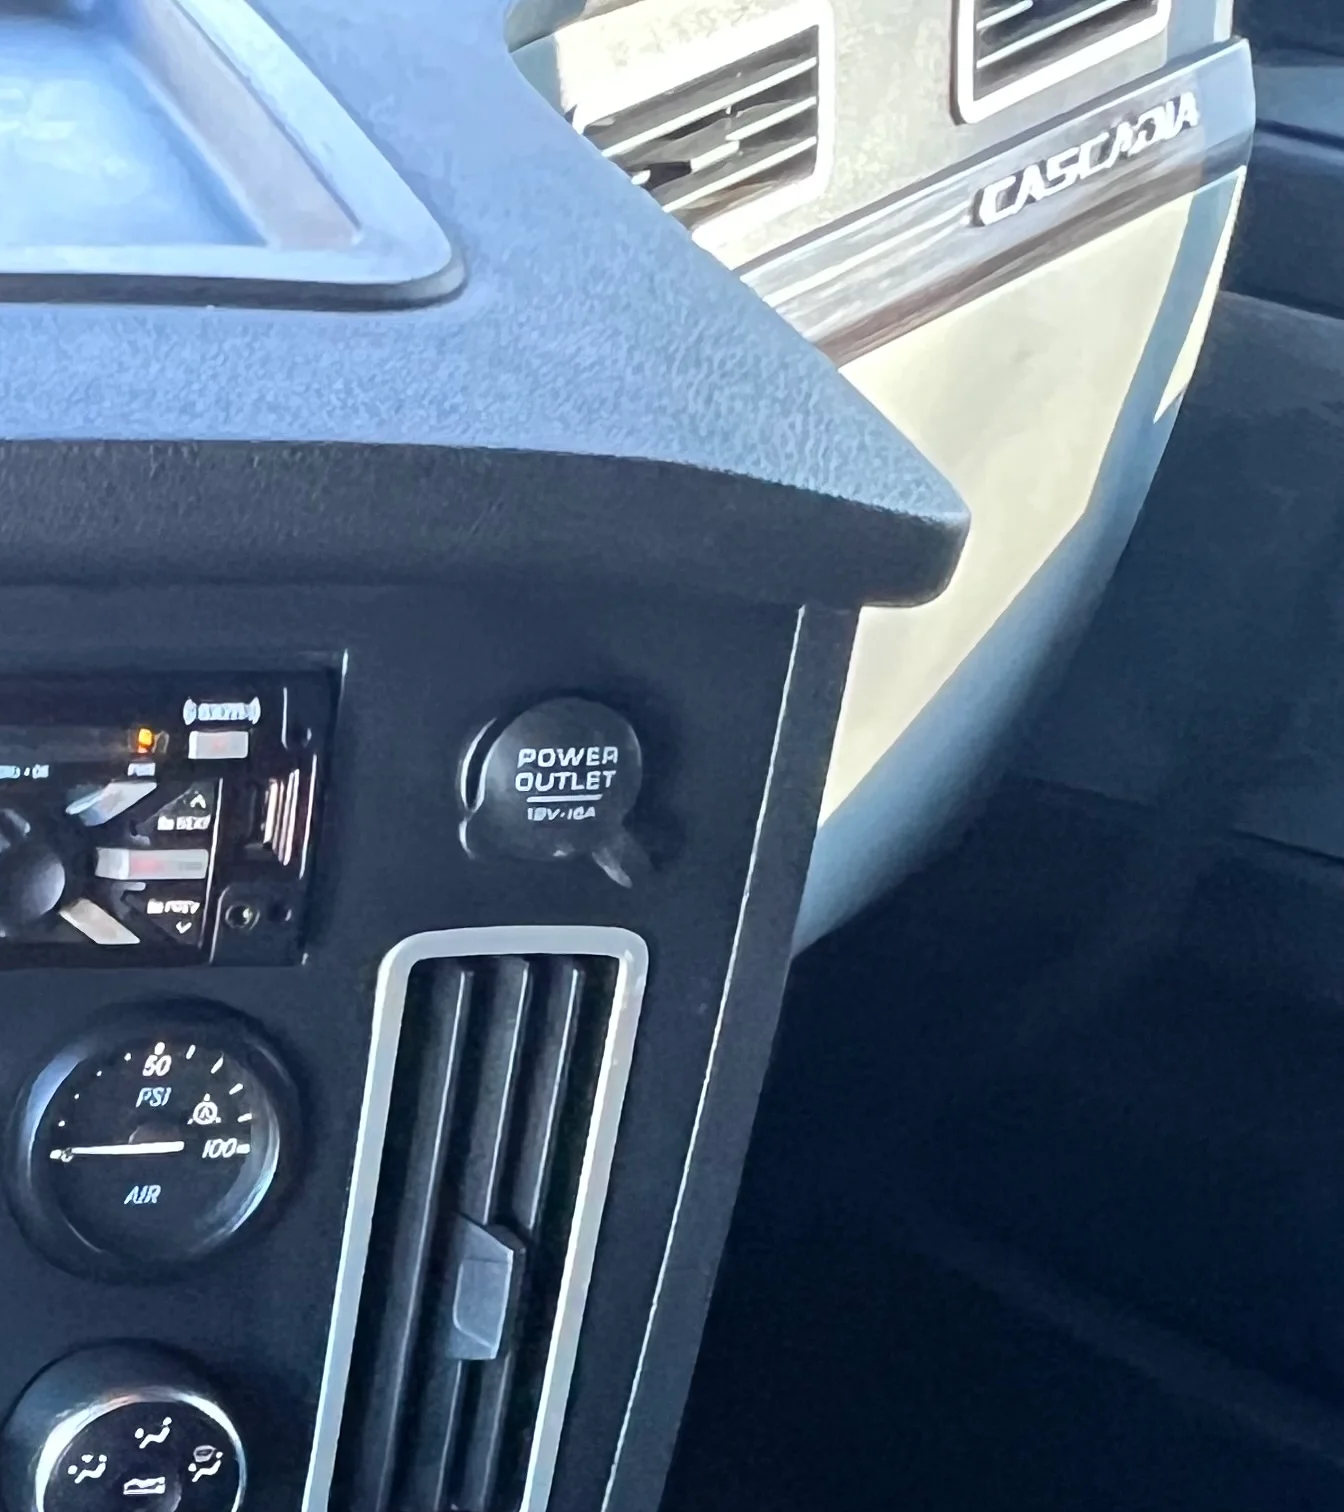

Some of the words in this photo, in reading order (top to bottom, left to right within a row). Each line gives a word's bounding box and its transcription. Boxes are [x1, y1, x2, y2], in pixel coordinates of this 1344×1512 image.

[979, 91, 1200, 226] CASCADIA
[517, 745, 618, 768] POWER
[515, 770, 617, 792] OUTLET
[142, 1054, 173, 1077] 50
[135, 1086, 173, 1109] PSI
[201, 1138, 238, 1160] 100
[123, 1184, 162, 1206] AIR
